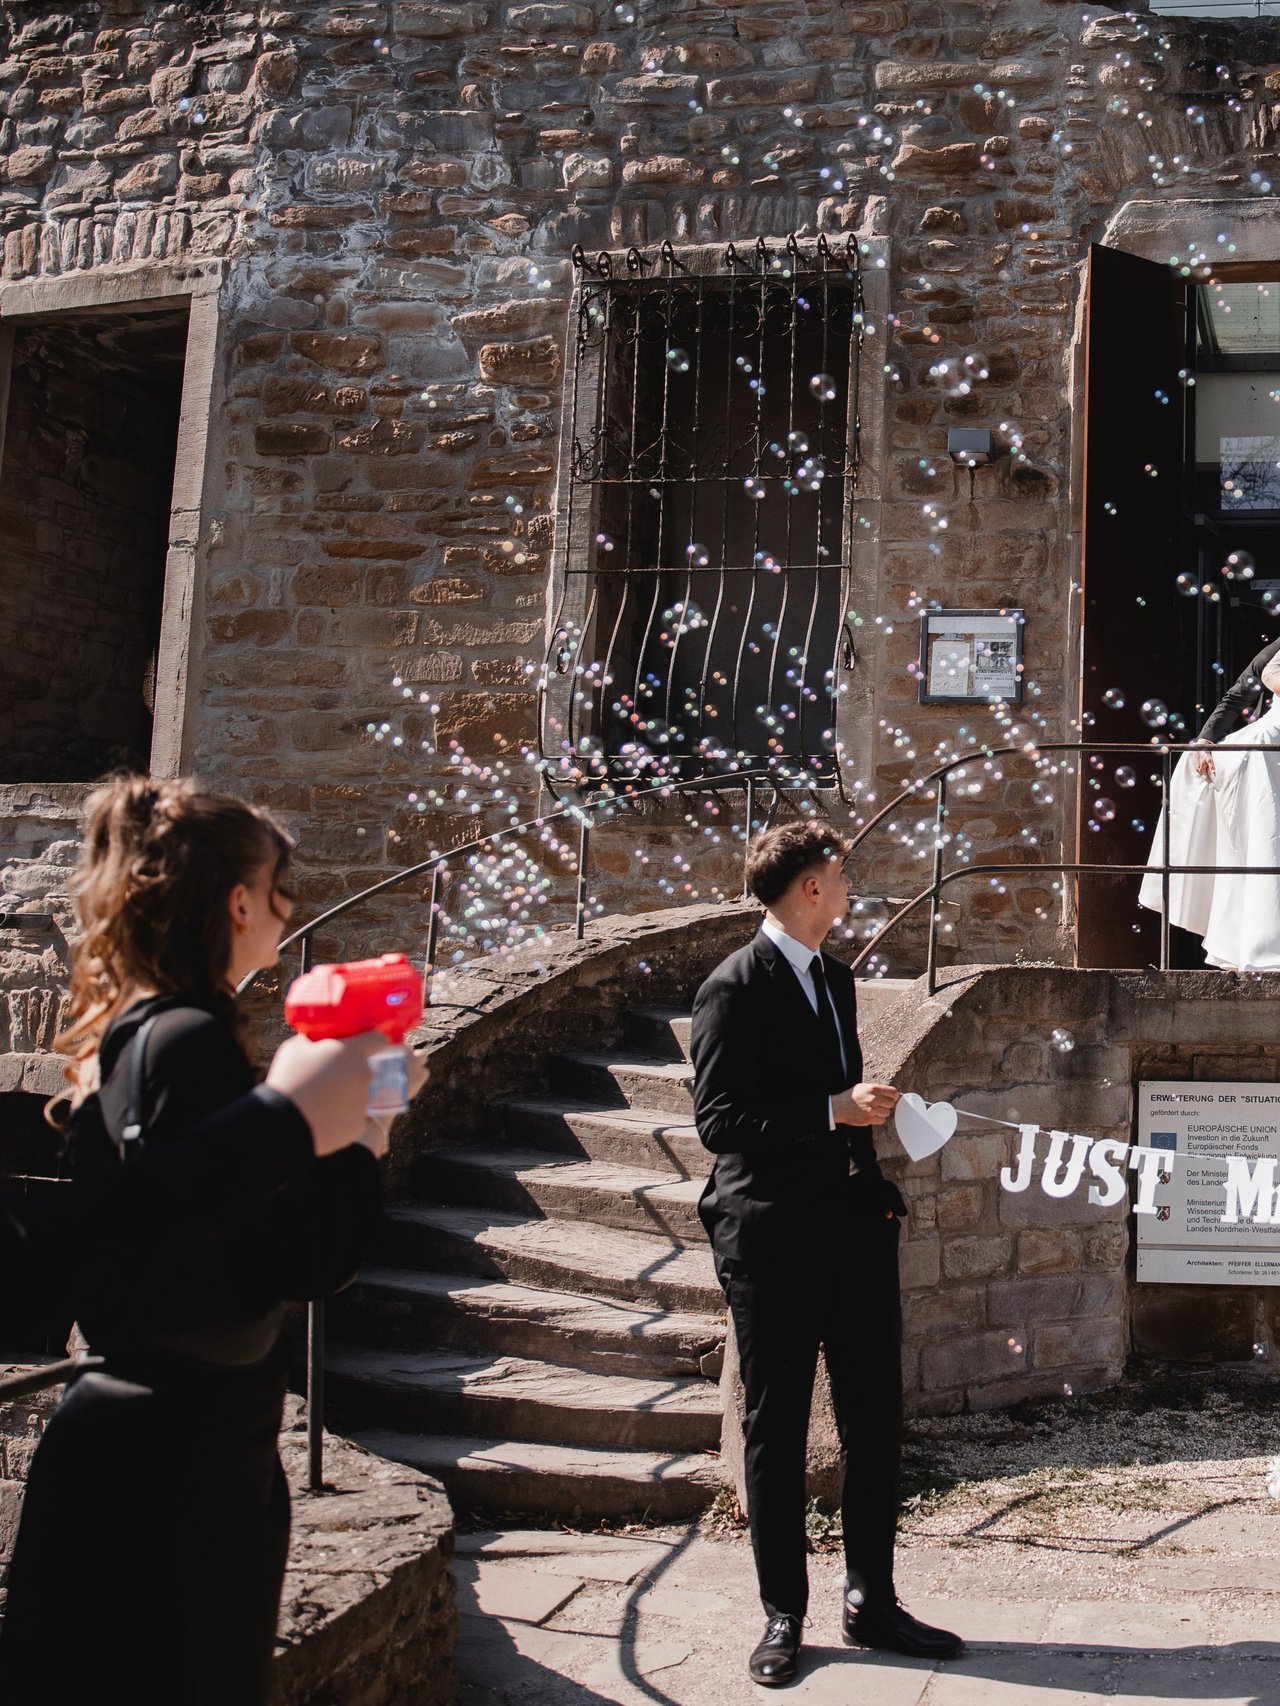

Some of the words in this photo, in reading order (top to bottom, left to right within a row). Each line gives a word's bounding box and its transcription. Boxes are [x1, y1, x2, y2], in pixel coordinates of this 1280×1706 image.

[1218, 1095, 1236, 1103] DER
[1150, 1109, 1179, 1117] gefördert
[1187, 1124, 1248, 1133] EUROPÄISCHE
[1250, 1125, 1277, 1133] UNION
[1242, 1134, 1270, 1142] Zukunft
[1187, 1143, 1235, 1151] Europäischer
[1236, 1143, 1259, 1151] Fonds
[1000, 1123, 1175, 1215] JUST
[1186, 1225, 1213, 1233] Landes
